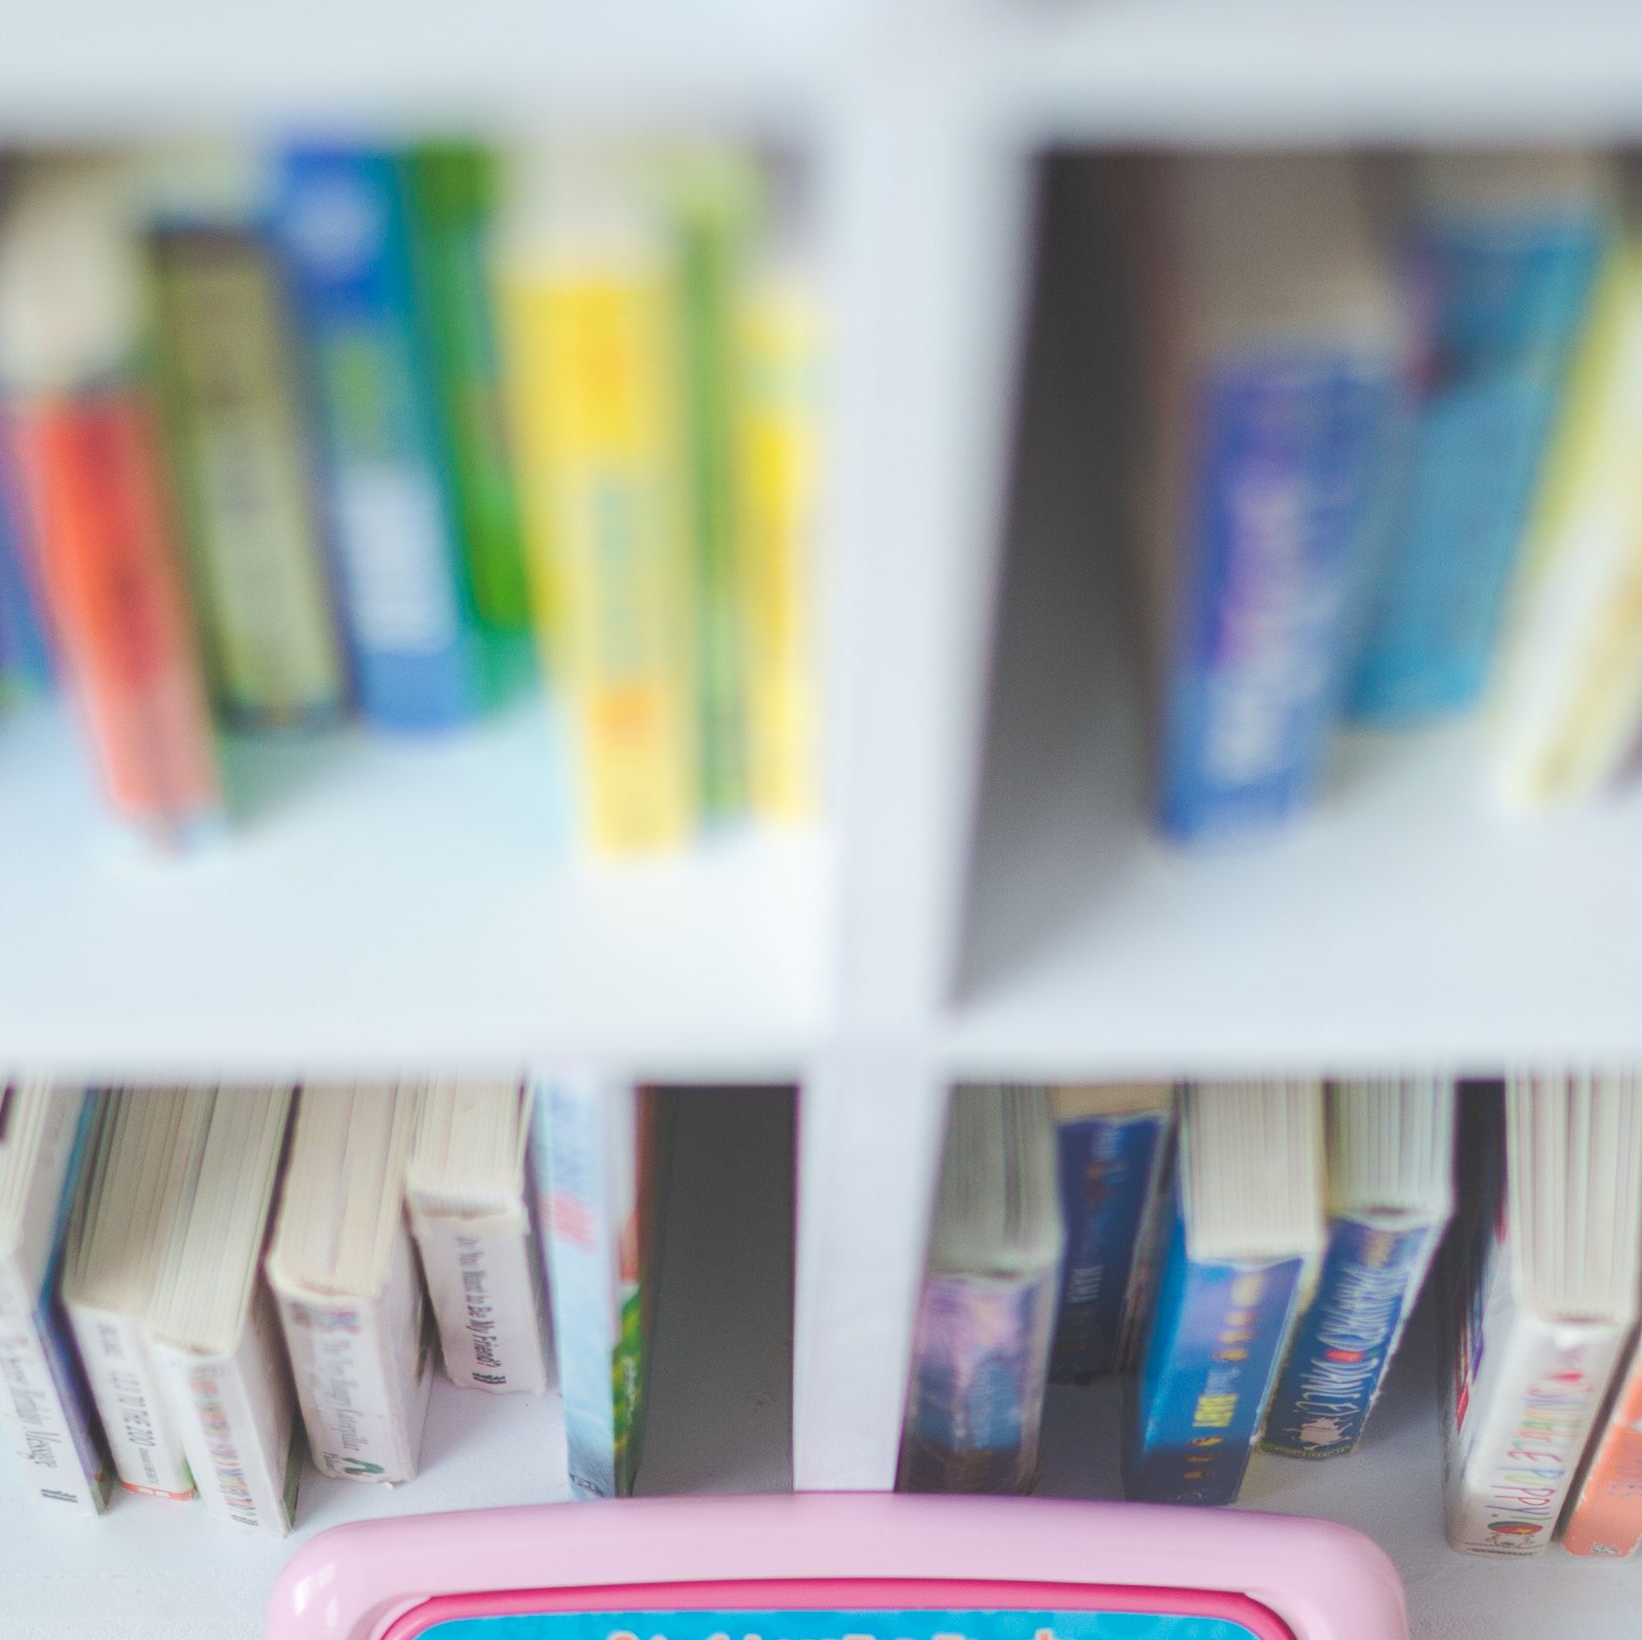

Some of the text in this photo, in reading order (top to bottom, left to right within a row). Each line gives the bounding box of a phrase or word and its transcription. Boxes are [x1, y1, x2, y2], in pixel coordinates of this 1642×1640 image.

[467, 1305, 493, 1318] Be
[466, 1319, 496, 1333] My
[472, 1334, 502, 1368] Friend?
[1485, 1466, 1566, 1521] PUPPY!
